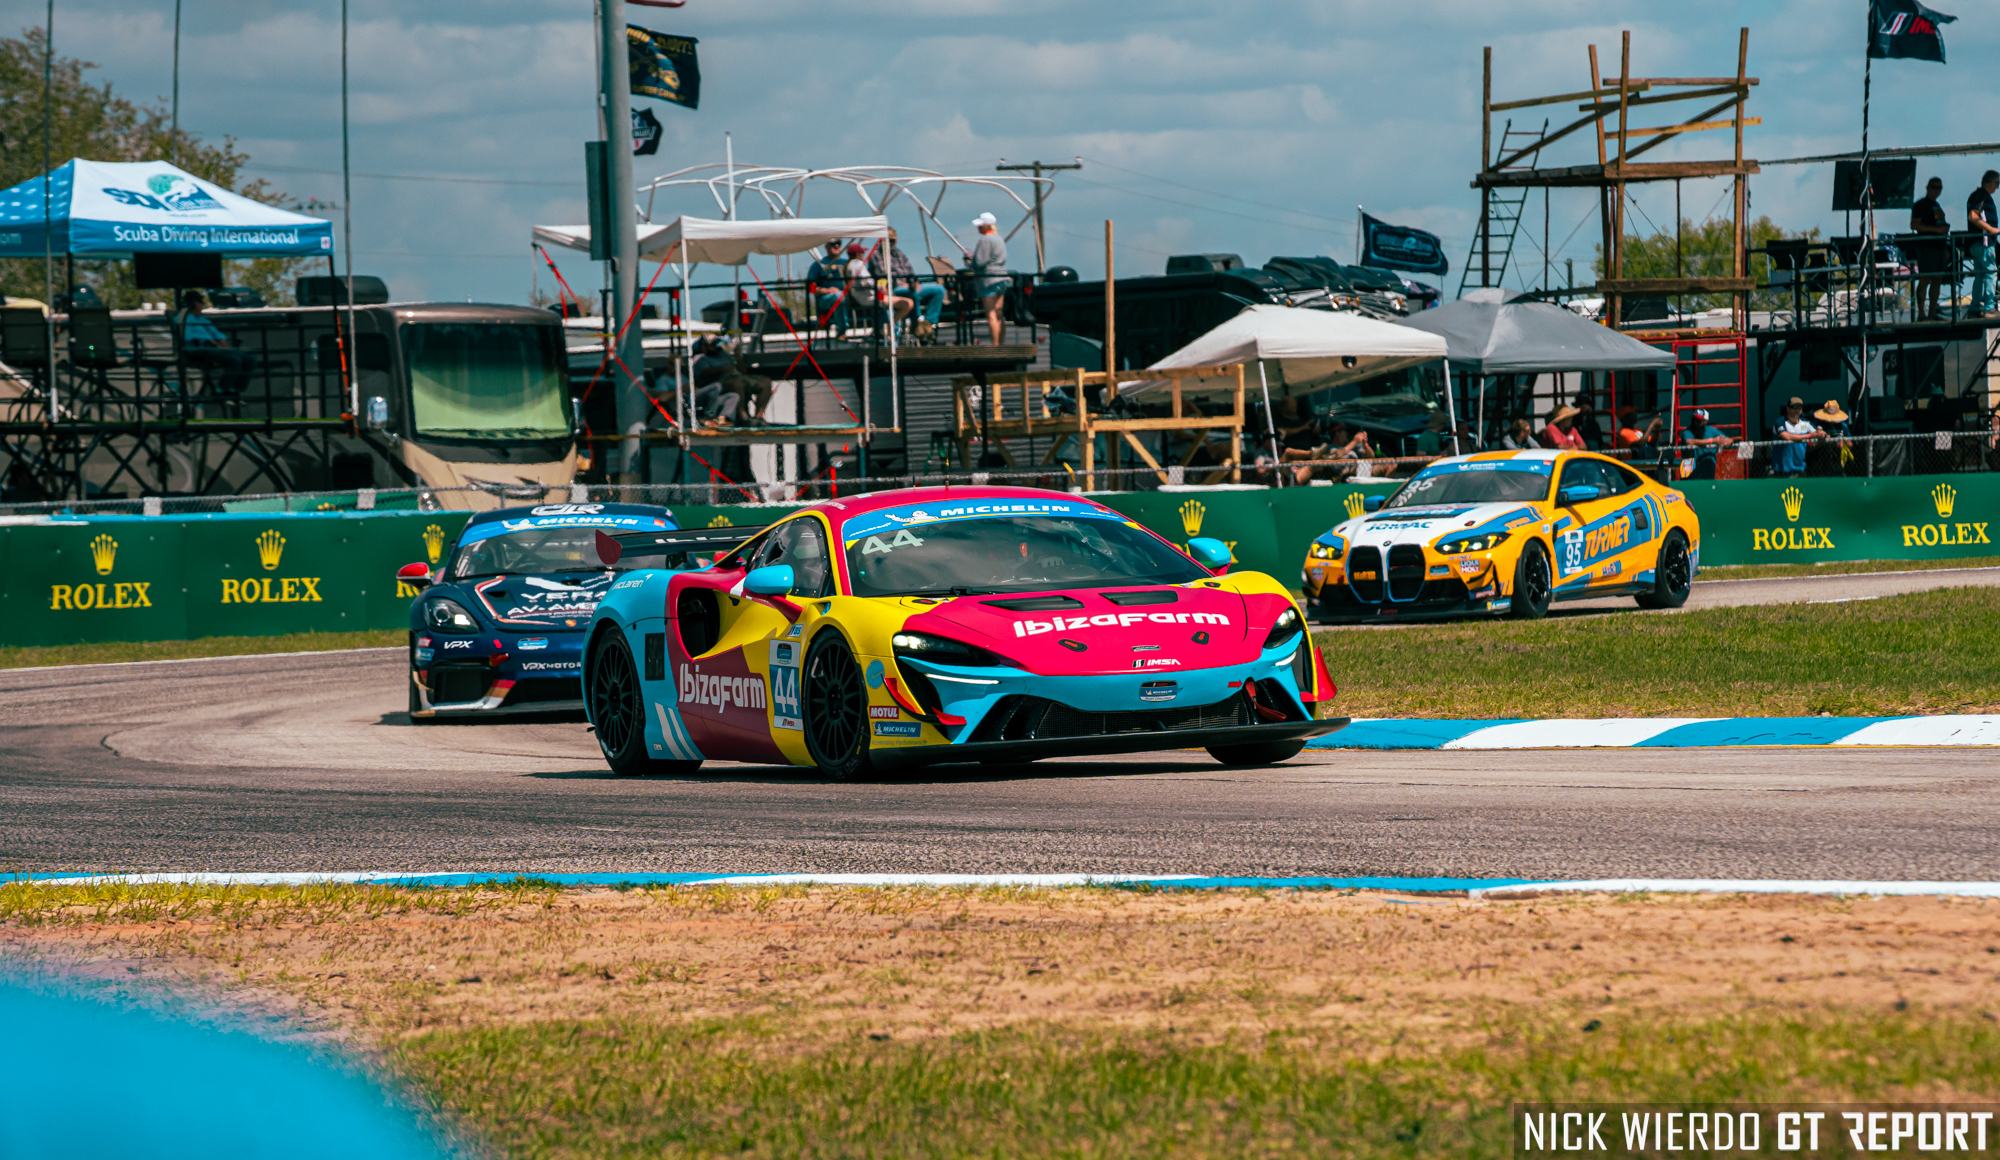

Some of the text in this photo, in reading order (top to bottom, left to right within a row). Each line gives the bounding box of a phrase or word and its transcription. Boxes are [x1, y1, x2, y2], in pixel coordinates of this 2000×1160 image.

[113, 225, 299, 247] Scuba Diving International
[537, 516, 638, 525] MICHELIN
[941, 505, 1070, 517] MICHELIN
[862, 529, 925, 555] 44
[1584, 515, 1631, 561] TURNER
[1752, 527, 1836, 550] ROLEX
[1901, 522, 1991, 547] ROLEX
[1565, 543, 1582, 567] 95
[50, 582, 153, 610] ROLEX
[221, 577, 323, 603] ROLEX
[444, 640, 474, 649] VPX
[774, 667, 799, 715] 44
[870, 707, 898, 718] MOTUL
